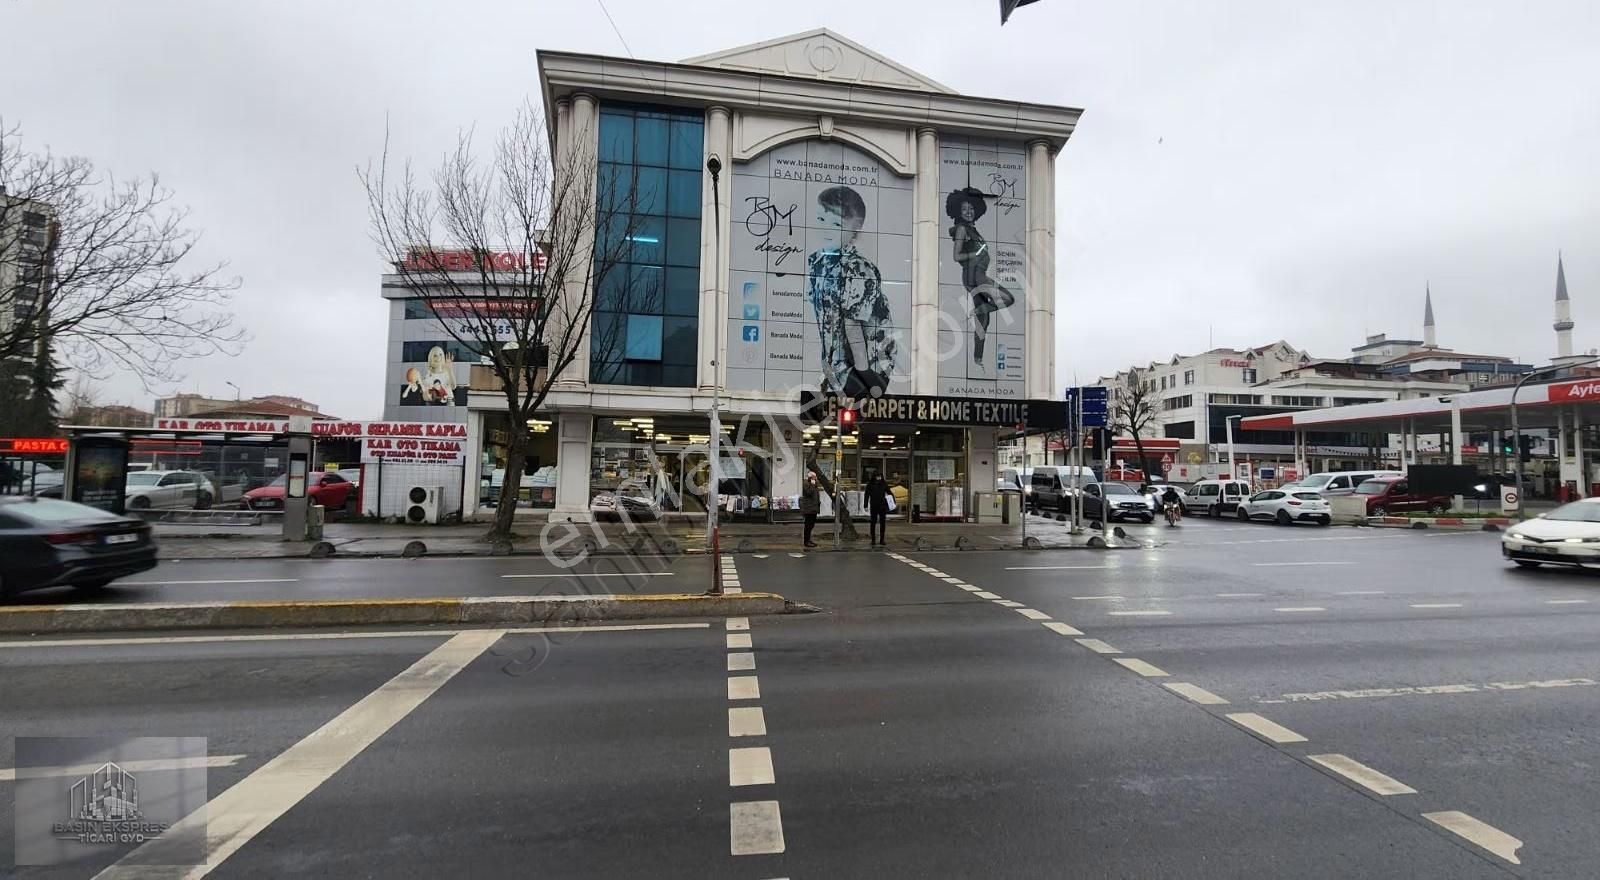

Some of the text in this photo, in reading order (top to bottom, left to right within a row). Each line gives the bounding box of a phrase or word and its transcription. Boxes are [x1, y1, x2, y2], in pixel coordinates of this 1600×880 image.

[775, 157, 878, 173] www.banadamoda.com.tr
[943, 159, 1023, 170] www.banadamoda.com.tr
[774, 169, 877, 186] BANADA MODA
[754, 238, 803, 266] design
[949, 387, 1015, 396] BANADA MODA
[860, 398, 915, 420] CARPET
[917, 400, 928, 420] &
[929, 400, 970, 421] HOME
[974, 402, 1029, 423] TEXTILE
[425, 424, 467, 437] KAPLA
[14, 440, 57, 450] PASTA
[367, 439, 392, 449] KAR
